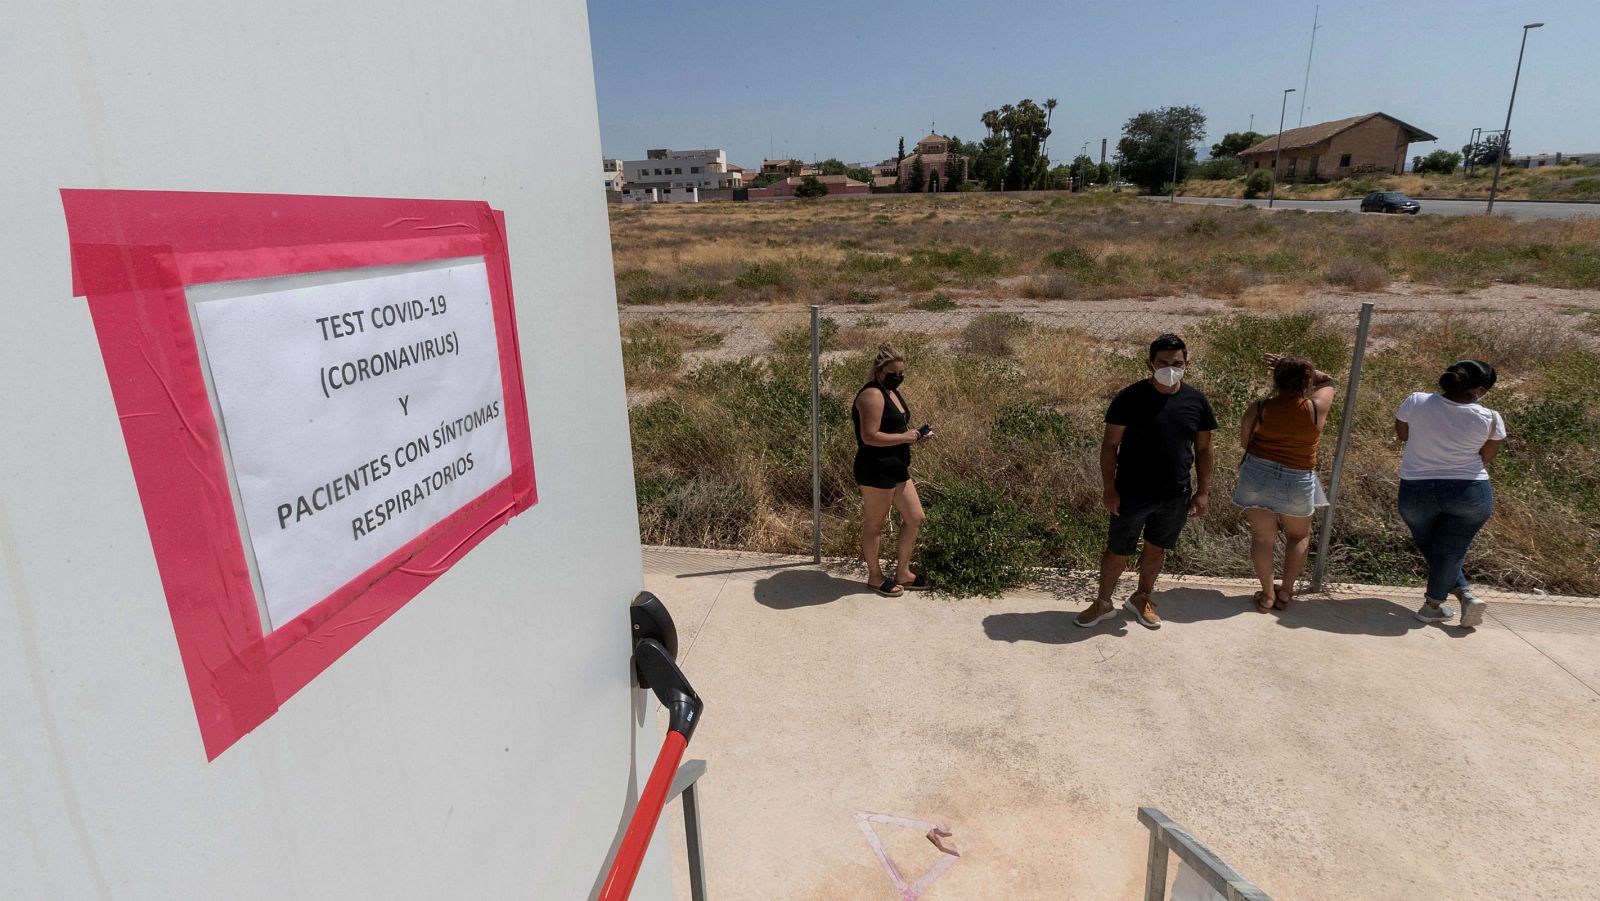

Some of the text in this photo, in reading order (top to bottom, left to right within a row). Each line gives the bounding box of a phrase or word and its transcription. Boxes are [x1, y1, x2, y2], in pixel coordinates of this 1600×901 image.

[315, 294, 447, 341] TEST COVID-19
[320, 330, 460, 399] (CORONAVIRUS)
[398, 394, 410, 417] Y
[276, 400, 500, 530] PACIENTES CON SÍNTOMAS
[351, 452, 475, 541] RESPIRATORIOS
